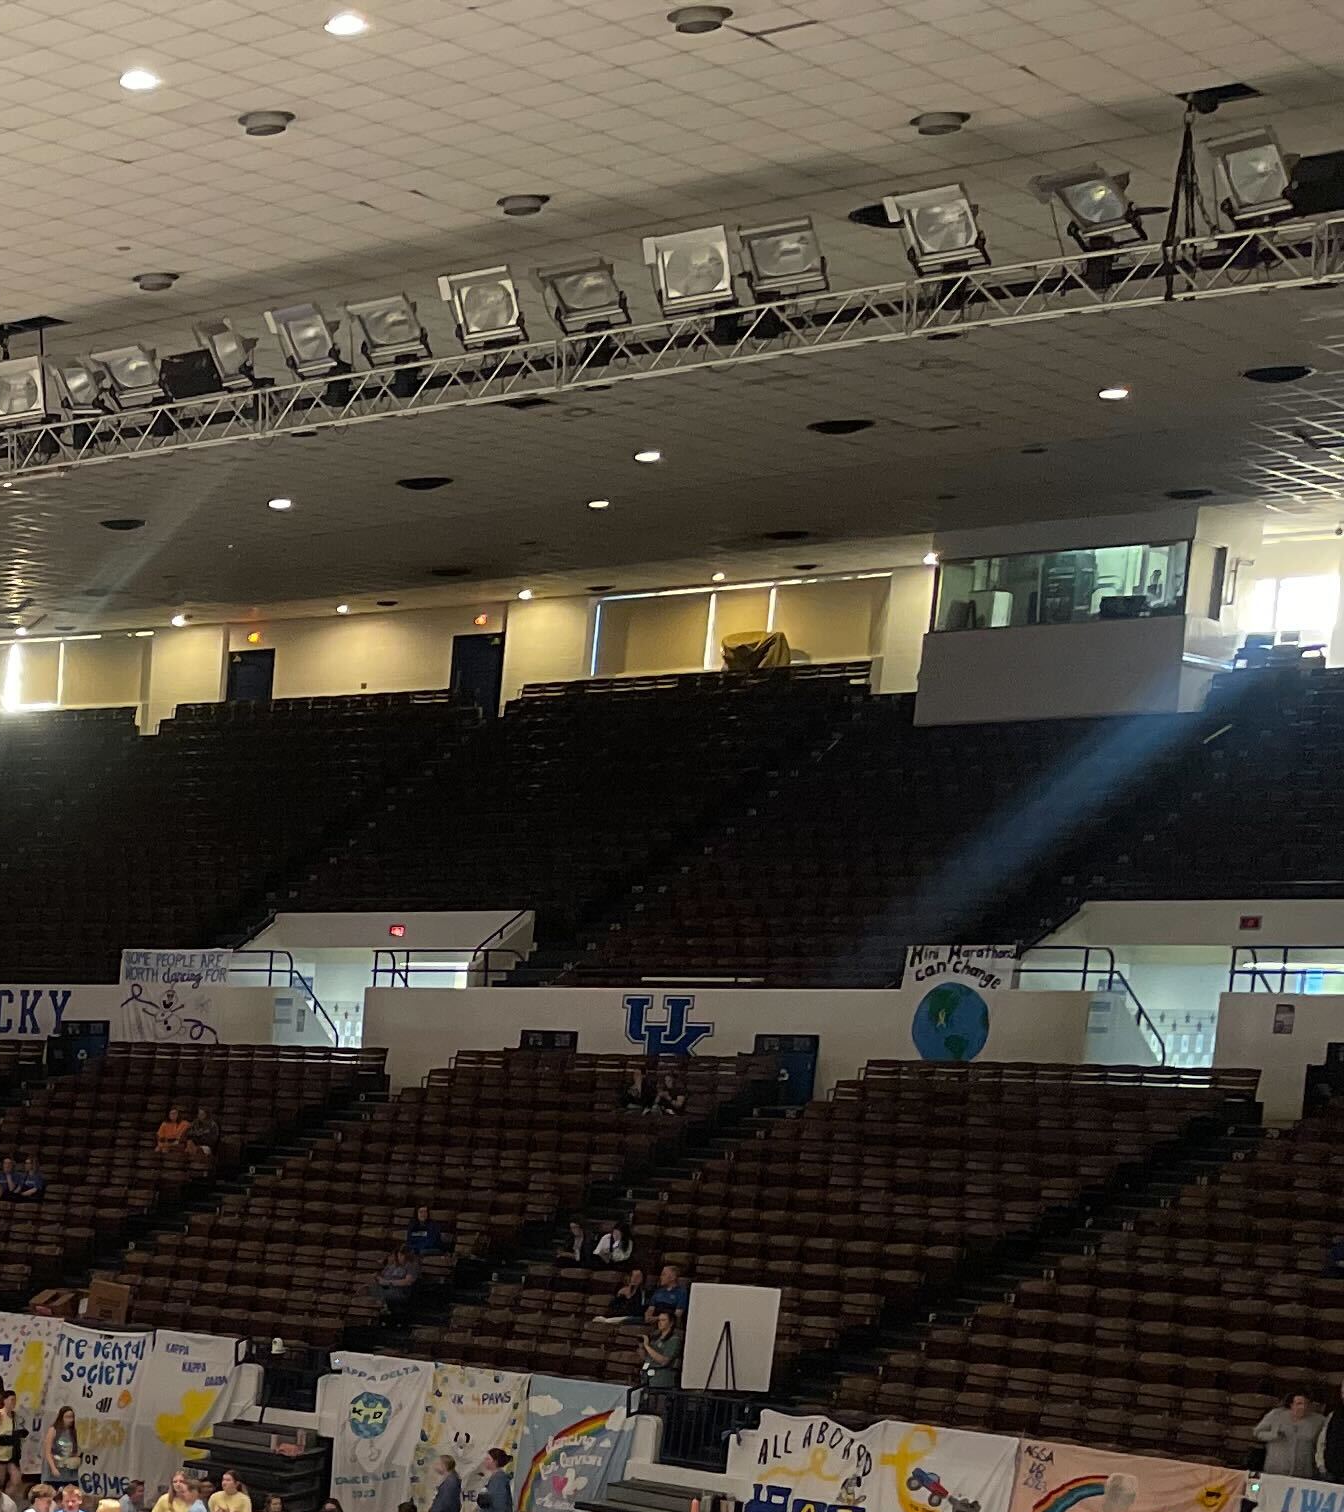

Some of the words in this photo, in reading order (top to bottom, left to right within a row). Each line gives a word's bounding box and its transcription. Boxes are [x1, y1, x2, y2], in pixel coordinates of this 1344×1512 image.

[156, 952, 197, 968] PEOPLE
[200, 953, 225, 969] ARE
[909, 944, 939, 968] Mini
[204, 968, 228, 983] FOR
[915, 961, 947, 982] can
[622, 994, 715, 1057] UK
[379, 1364, 420, 1382] DELTA
[481, 1390, 512, 1406] PAWS
[757, 1431, 793, 1465] ALL
